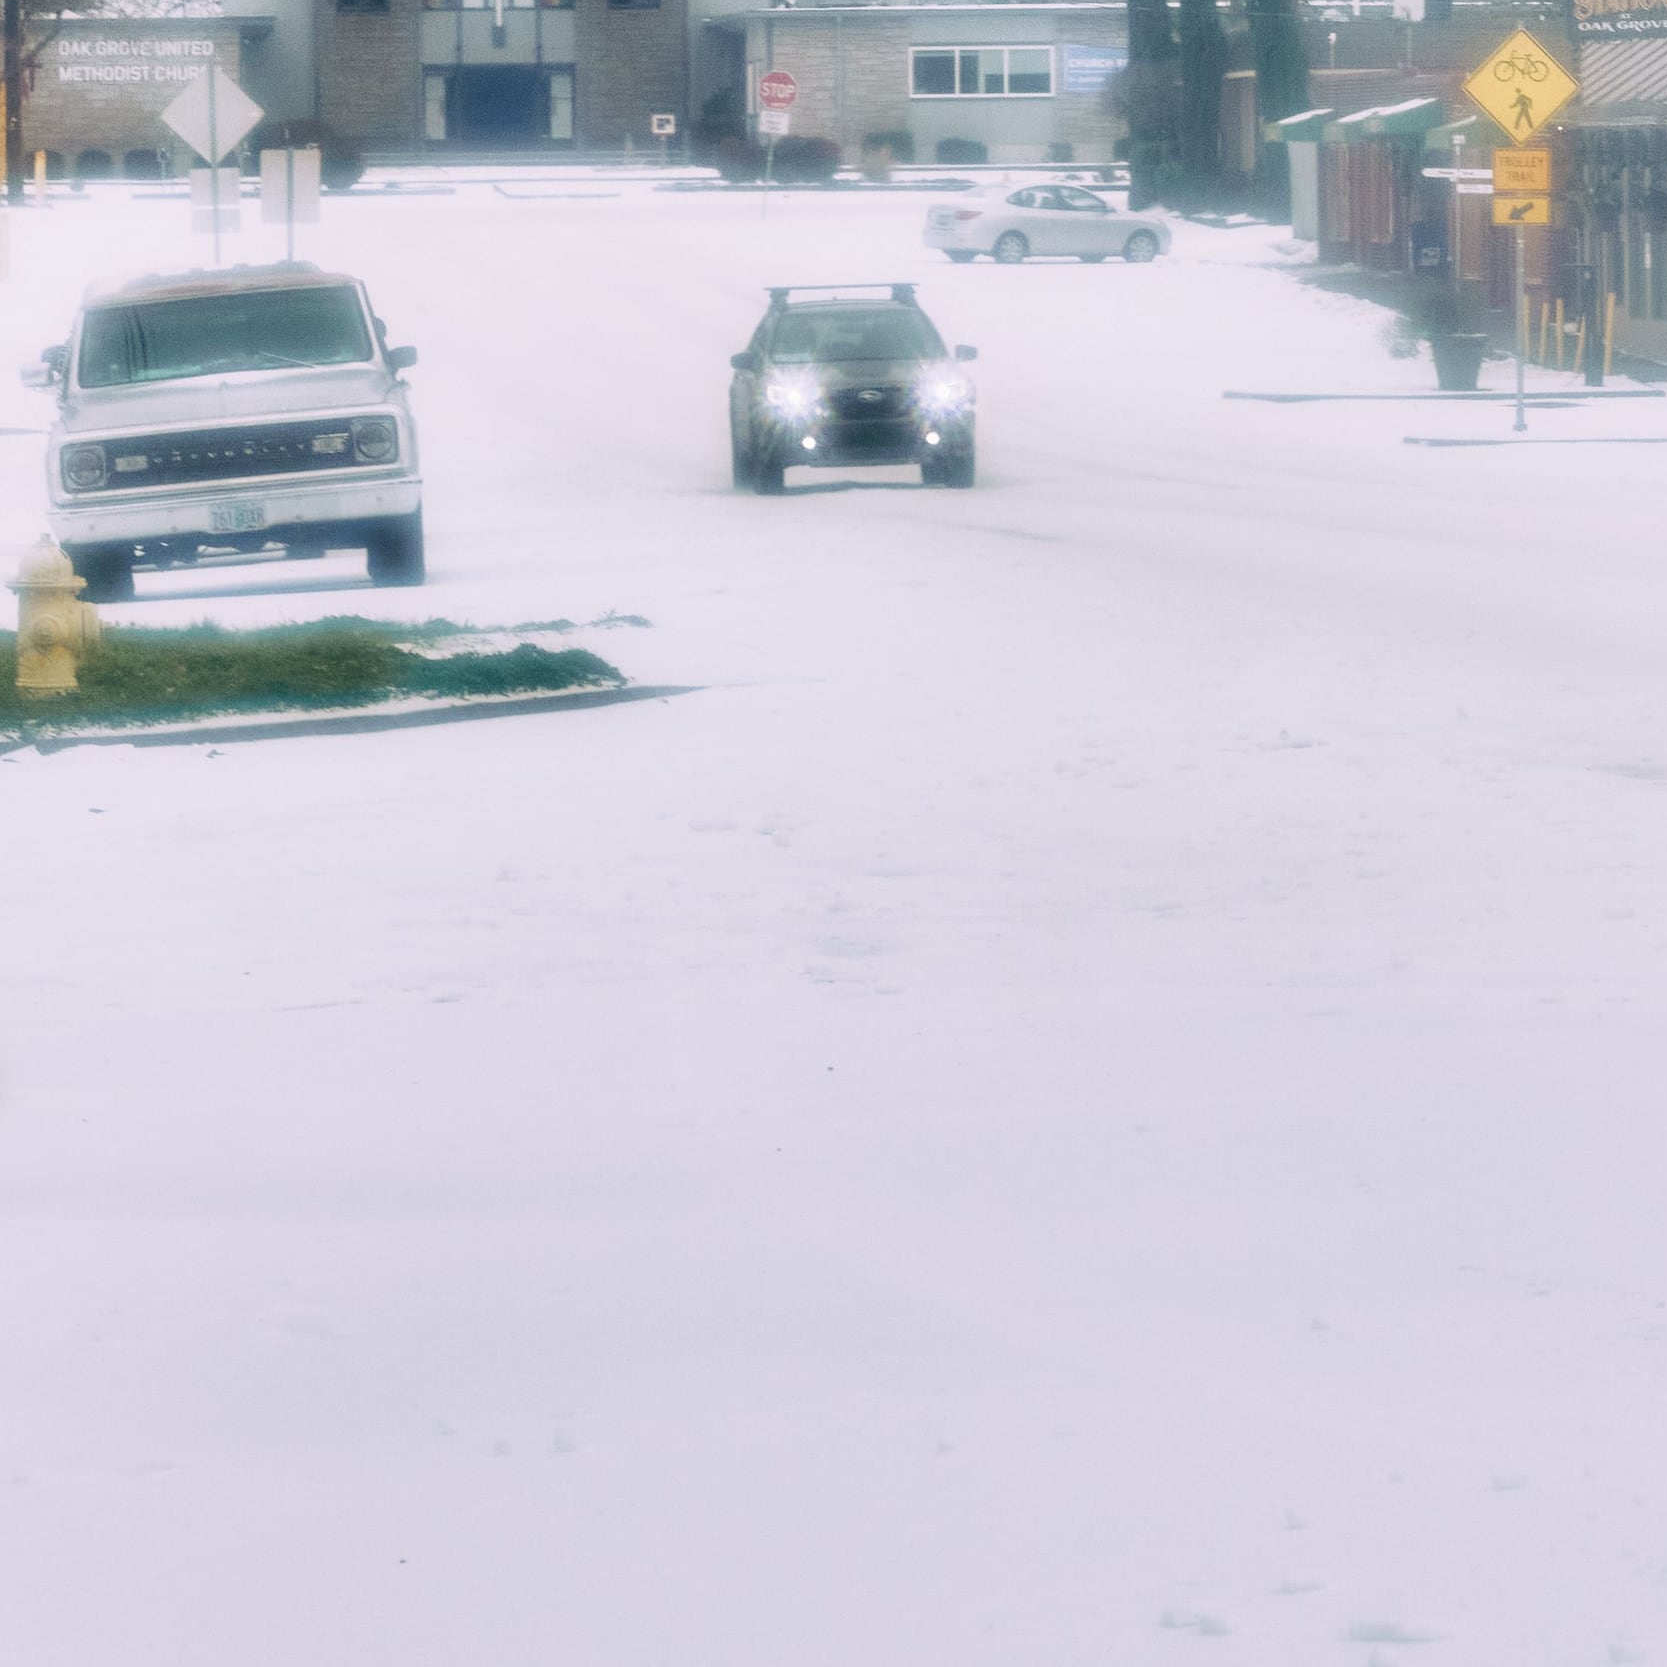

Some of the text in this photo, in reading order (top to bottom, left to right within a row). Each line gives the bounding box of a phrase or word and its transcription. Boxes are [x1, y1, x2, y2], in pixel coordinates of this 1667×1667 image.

[1578, 21, 1615, 32] OAK
[58, 40, 214, 56] OAK GROVE UNITED
[59, 65, 150, 82] METHODIST
[761, 82, 795, 98] STOP
[1498, 156, 1544, 168] TROLLEY
[1506, 170, 1536, 182] TRAIL
